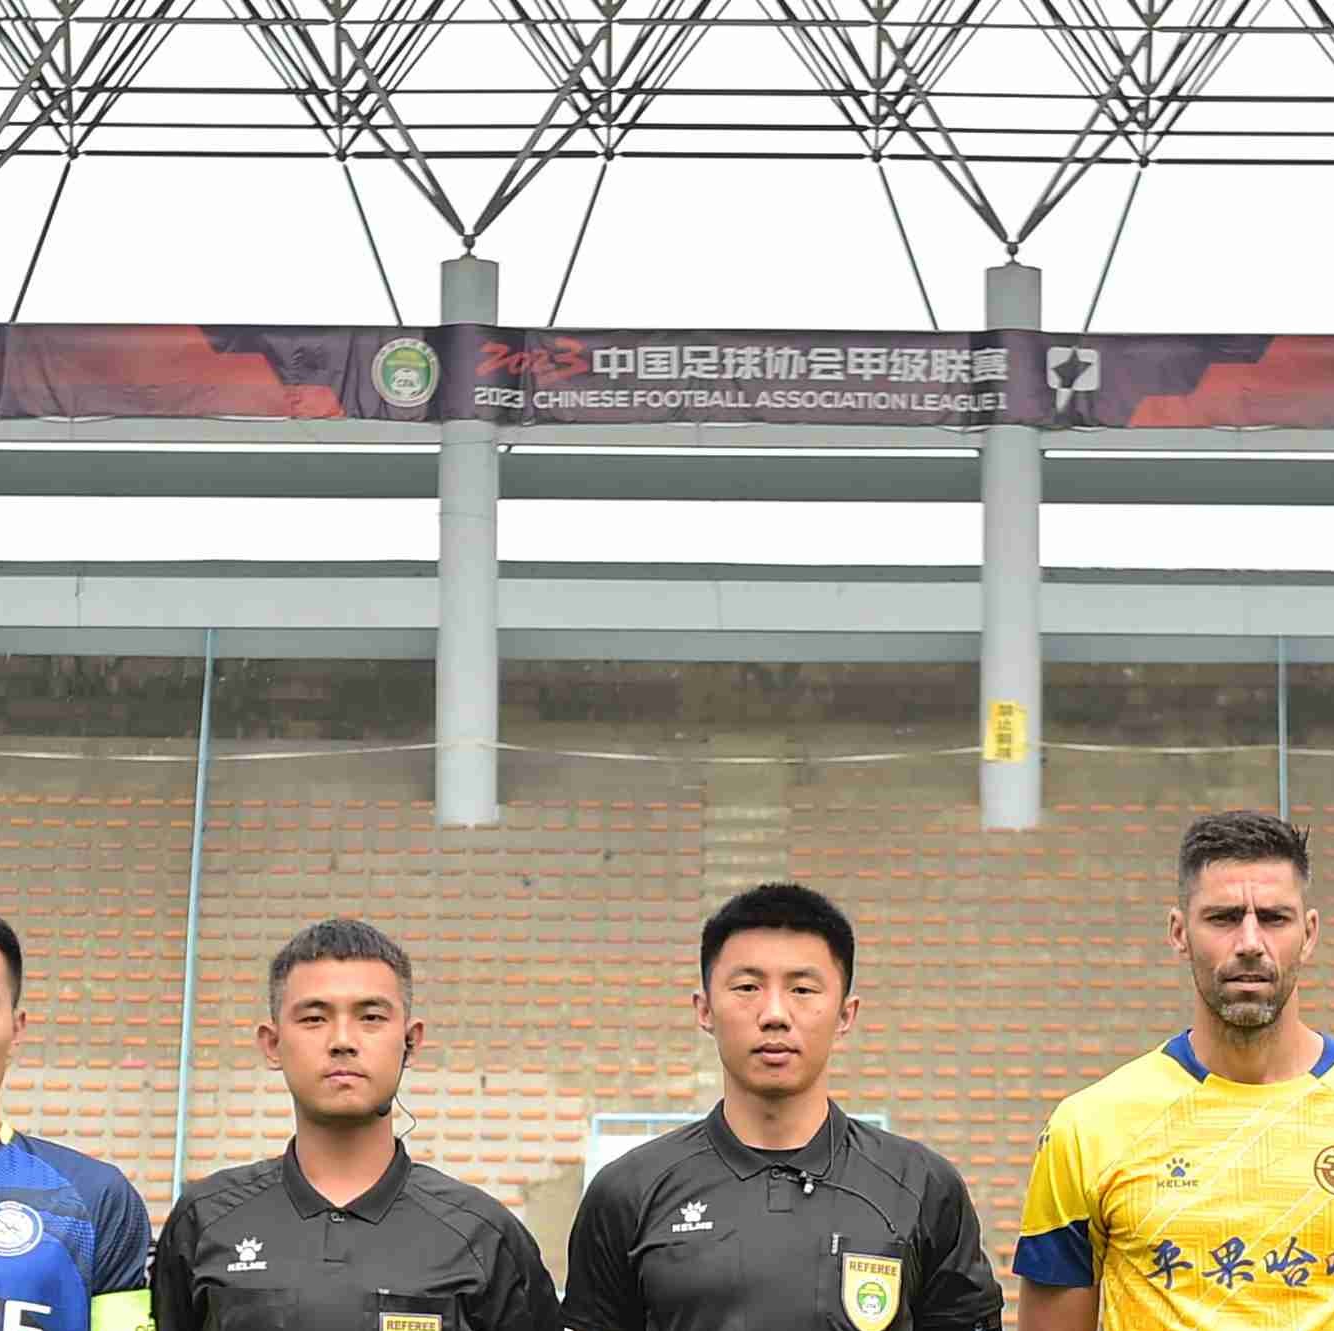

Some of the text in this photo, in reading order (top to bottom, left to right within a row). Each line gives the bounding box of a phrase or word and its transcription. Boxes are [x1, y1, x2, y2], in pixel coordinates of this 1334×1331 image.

[593, 346, 1008, 382] 中国足球协会甲级联赛
[475, 386, 524, 409] 2023
[533, 390, 631, 409] CHINESE
[633, 390, 751, 408] FOOTBALL
[755, 391, 908, 409] ASSOCIATION
[672, 1221, 714, 1232] KELME
[227, 1261, 268, 1272] KELME
[849, 1260, 898, 1276] REFEREE
[386, 1320, 437, 1331] REFEREE
